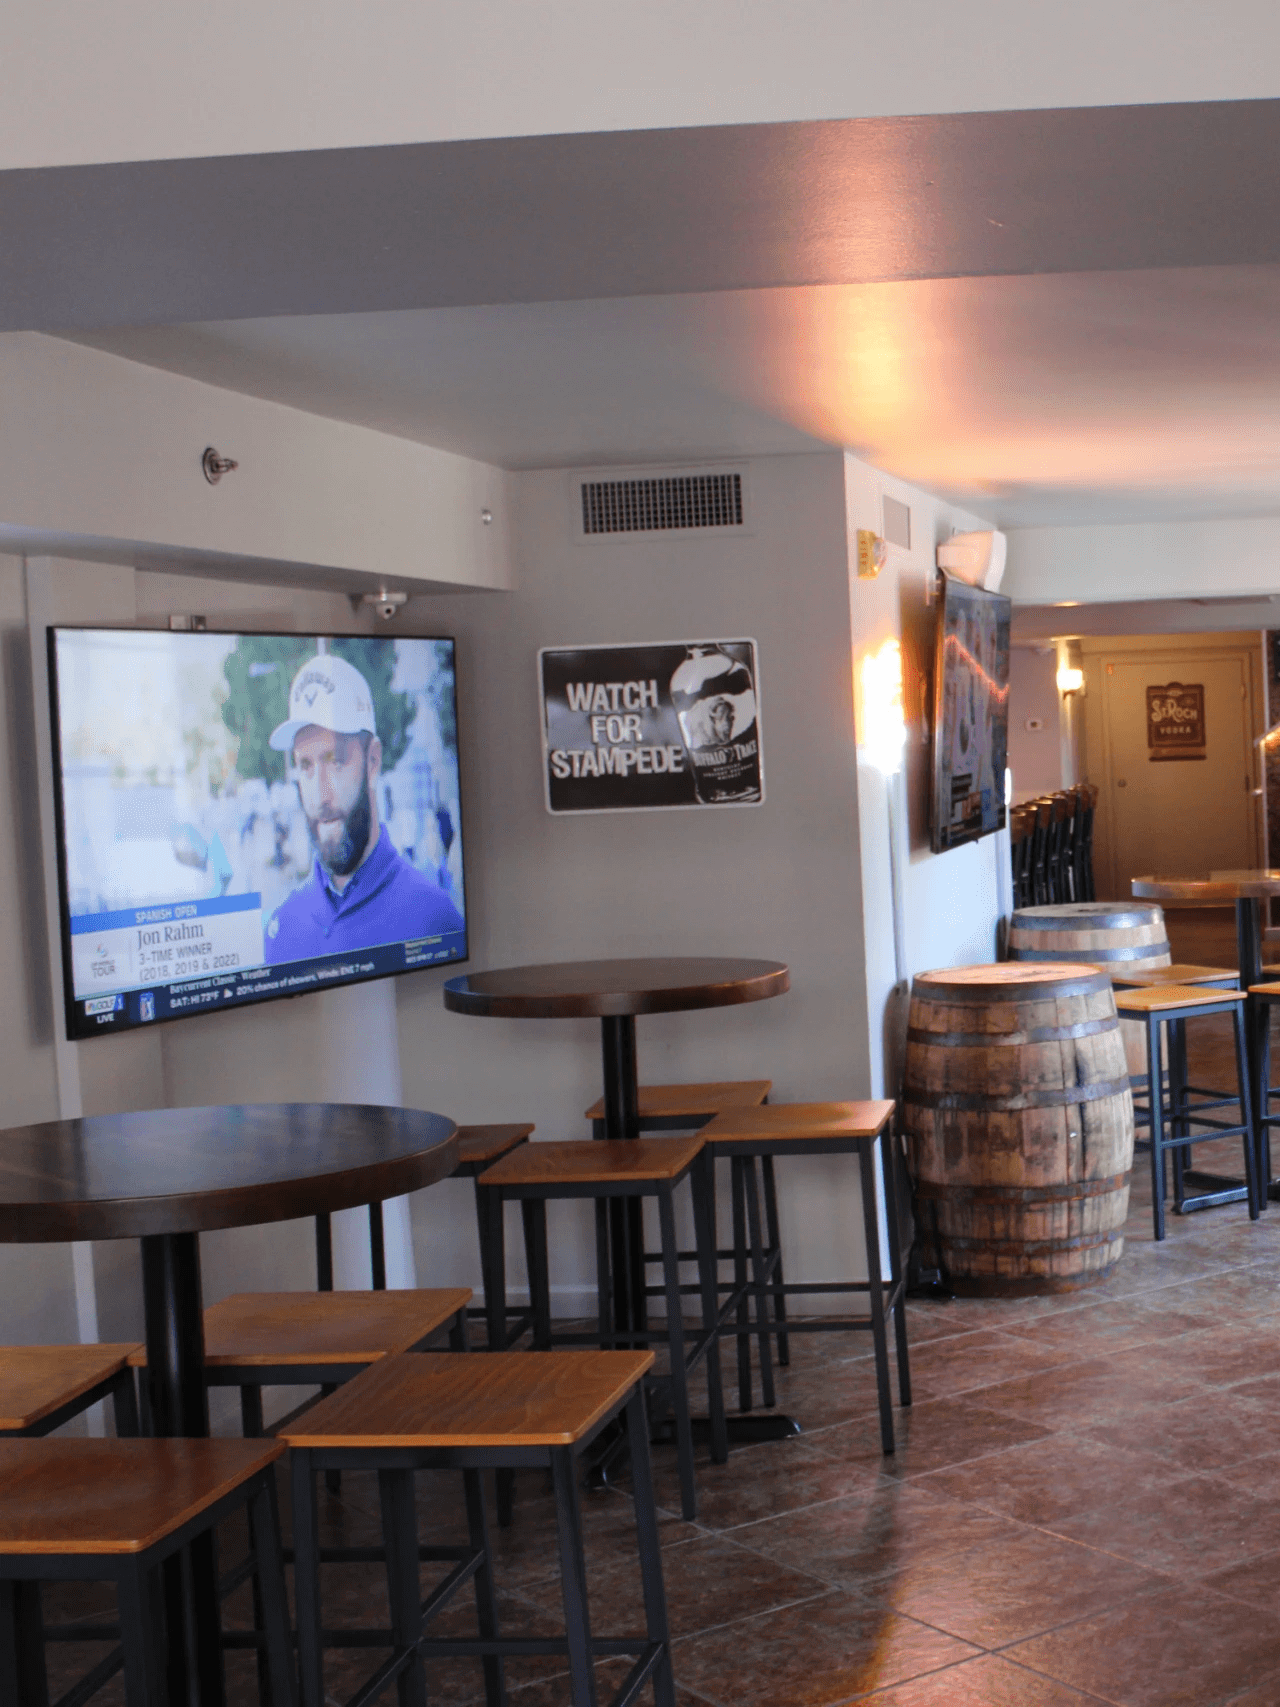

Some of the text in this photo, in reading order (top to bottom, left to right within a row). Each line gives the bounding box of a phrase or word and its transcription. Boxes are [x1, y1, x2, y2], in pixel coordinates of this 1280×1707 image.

[566, 679, 658, 712] WATCH
[590, 713, 643, 744] FOR
[551, 745, 684, 779] STAMPEDE
[135, 904, 198, 924] SPANISH OPEN
[137, 923, 204, 949] Jon Rahm
[139, 942, 213, 965] 3-TIME WINNER
[175, 960, 199, 976] 2019
[202, 958, 210, 970] &
[213, 953, 240, 968] 2022)
[92, 964, 116, 979] TOUR
[96, 1012, 115, 1024] LIVE
